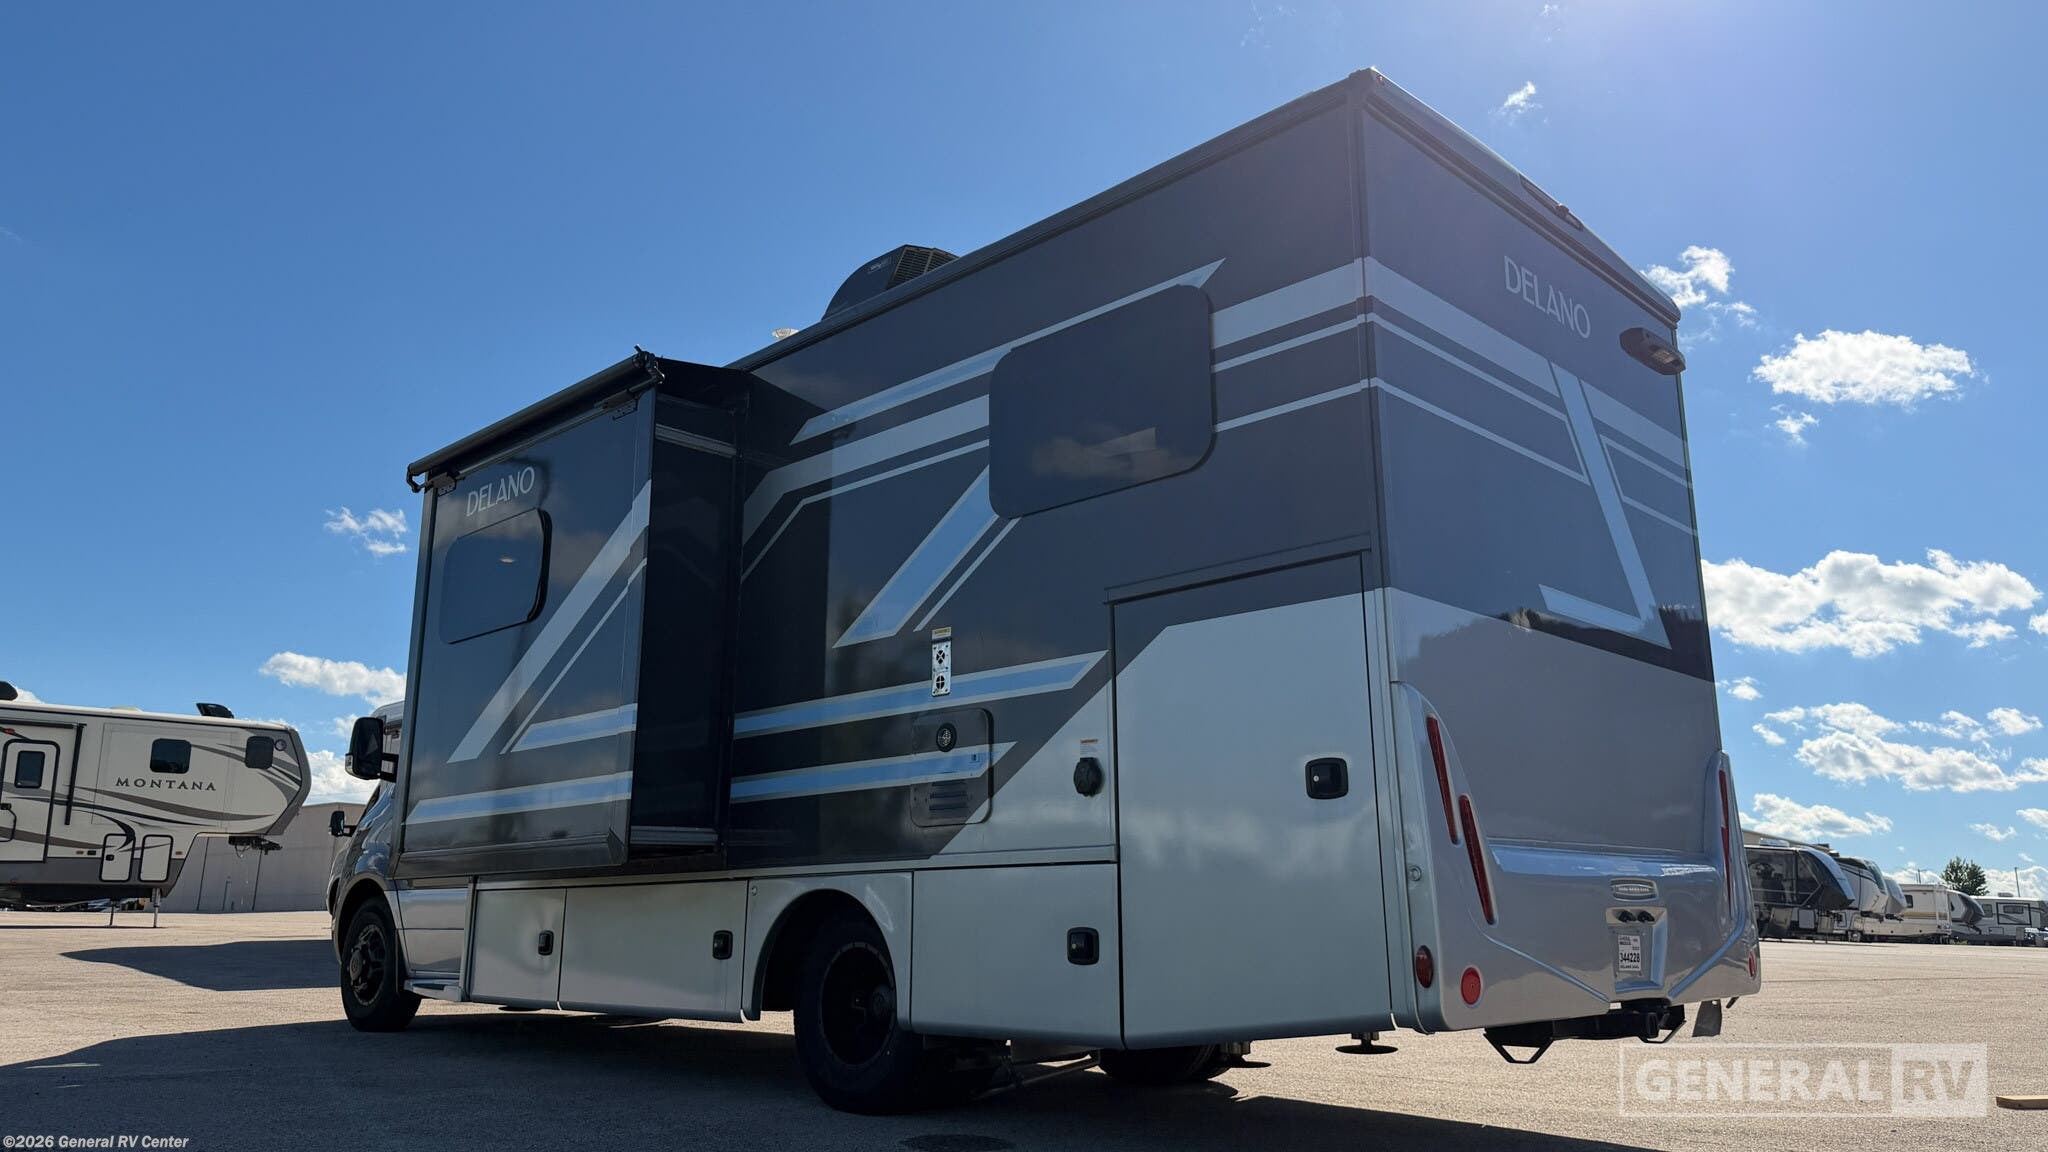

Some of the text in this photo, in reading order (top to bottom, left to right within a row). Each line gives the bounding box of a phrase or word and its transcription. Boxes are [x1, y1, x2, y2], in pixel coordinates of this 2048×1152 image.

[1504, 256, 1591, 339] DELANO
[466, 466, 535, 517] DELANO
[115, 777, 216, 791] MONTANA
